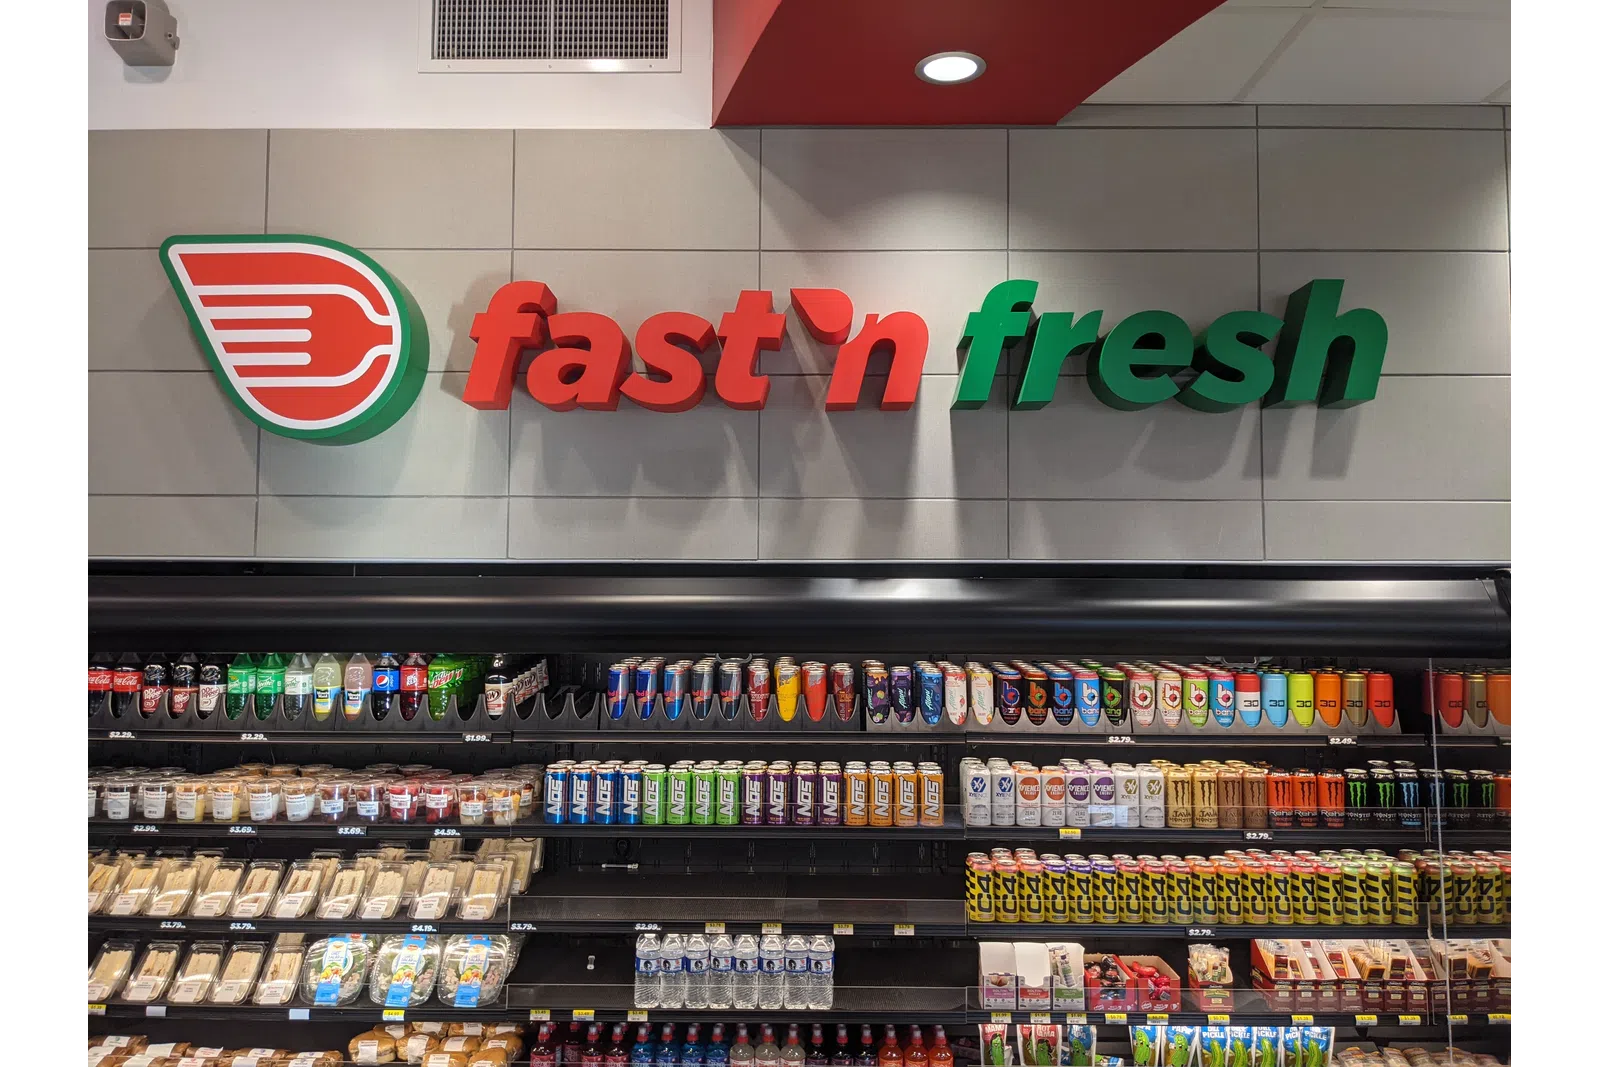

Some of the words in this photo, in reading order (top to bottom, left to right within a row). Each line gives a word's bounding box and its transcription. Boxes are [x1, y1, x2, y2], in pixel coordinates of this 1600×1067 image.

[950, 279, 1389, 413] fresh
[547, 775, 563, 816] NOS
[573, 775, 588, 816] NOS
[596, 775, 611, 816] NOS
[623, 775, 638, 816] NOS
[645, 775, 658, 816] NOS
[671, 775, 685, 816] NOS
[695, 775, 710, 816] NOS
[720, 775, 734, 816] NOS
[745, 775, 761, 817] NOS
[769, 775, 784, 817] NOS
[797, 775, 812, 817] NOS
[822, 776, 838, 817] NOS
[850, 775, 865, 817] NOS
[874, 776, 889, 818] NOS
[899, 776, 914, 818] NOS
[924, 776, 939, 818] NOS
[977, 875, 993, 913] C4
[1002, 876, 1018, 914] C4
[1026, 876, 1043, 914] C4
[1051, 876, 1067, 915] C4
[1076, 876, 1093, 915] C4
[1101, 876, 1118, 915] C4
[1125, 876, 1142, 915] C4
[1151, 876, 1167, 915] C4
[1177, 876, 1192, 916] C4
[1202, 876, 1218, 916] C4
[1226, 876, 1242, 916] C4
[1250, 876, 1267, 916] C4
[1274, 876, 1291, 916] C4
[1301, 876, 1318, 916] C4
[1202, 1031, 1225, 1039] PICKLE
[1230, 1031, 1250, 1039] ICKLE
